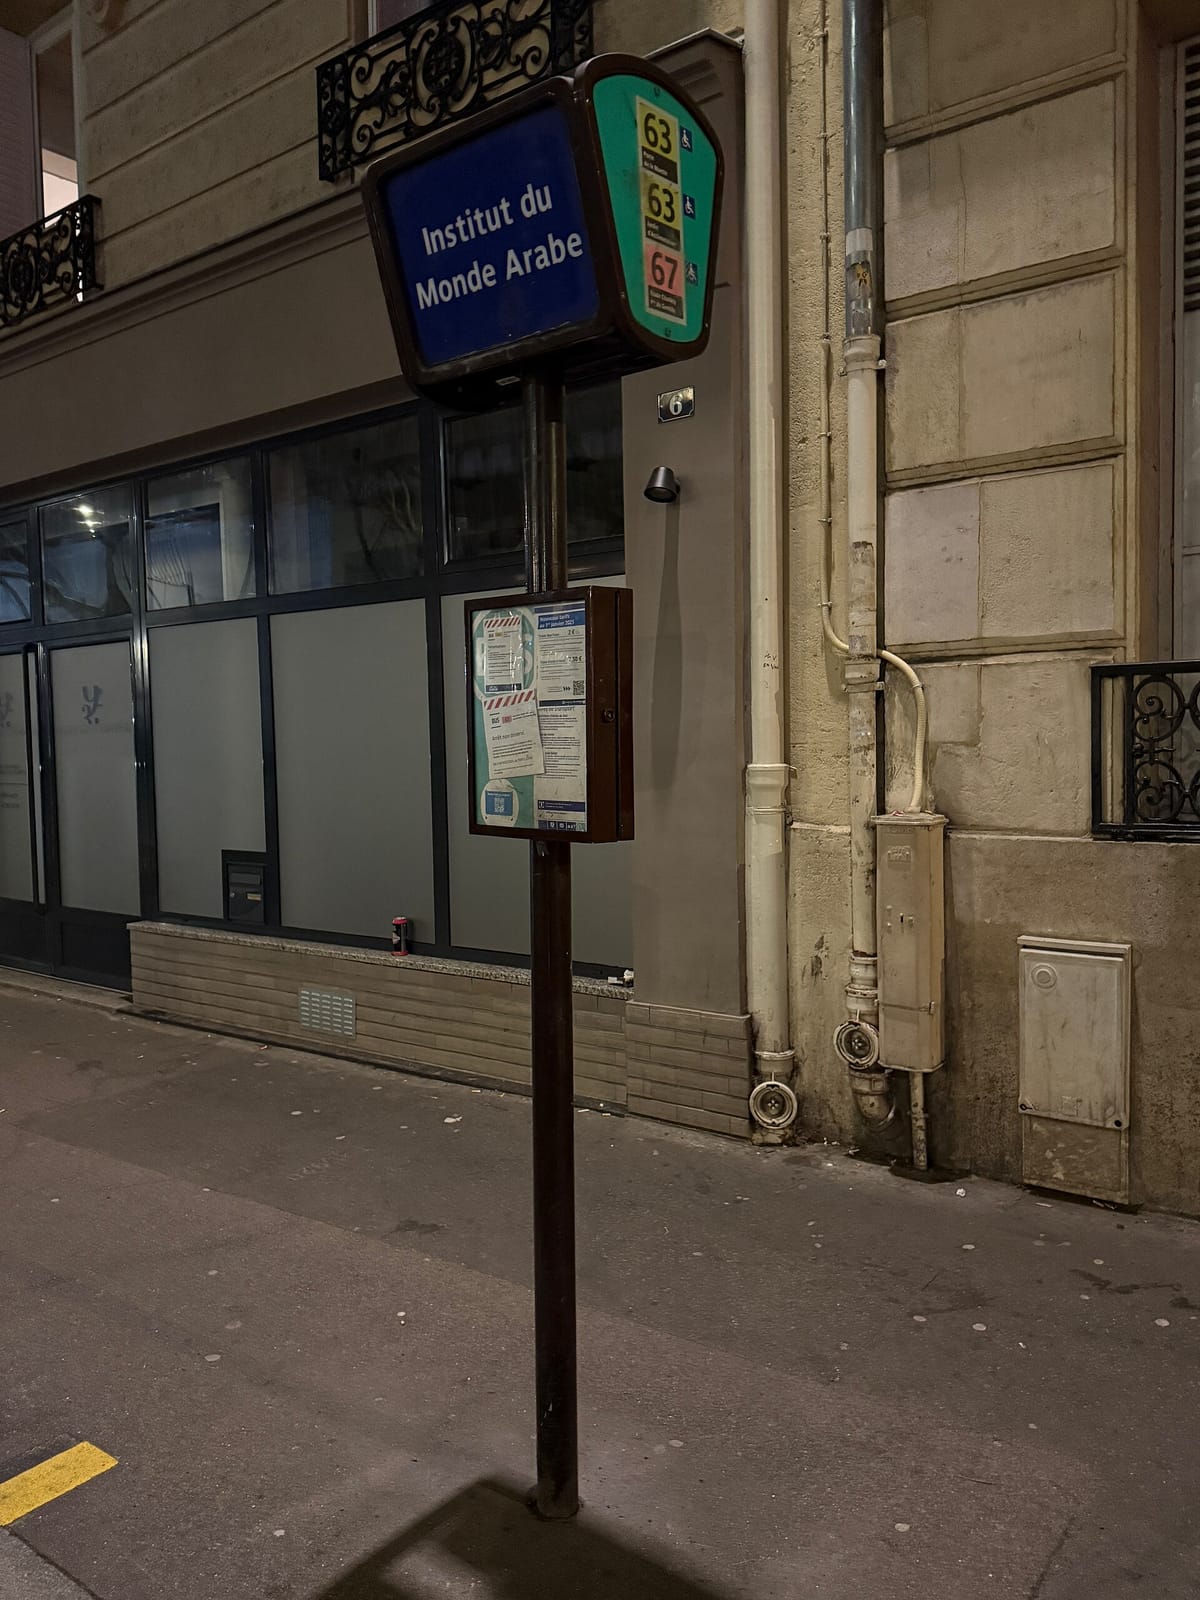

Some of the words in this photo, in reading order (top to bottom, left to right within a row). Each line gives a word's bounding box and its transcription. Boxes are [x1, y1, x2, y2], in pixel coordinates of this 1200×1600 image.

[644, 112, 672, 154] 63
[421, 197, 514, 256] Institut
[520, 183, 553, 218] du
[648, 183, 675, 223] 63
[415, 260, 497, 310] Monde
[506, 232, 584, 281] Arabe
[651, 251, 678, 290] 67
[669, 393, 683, 416] 6
